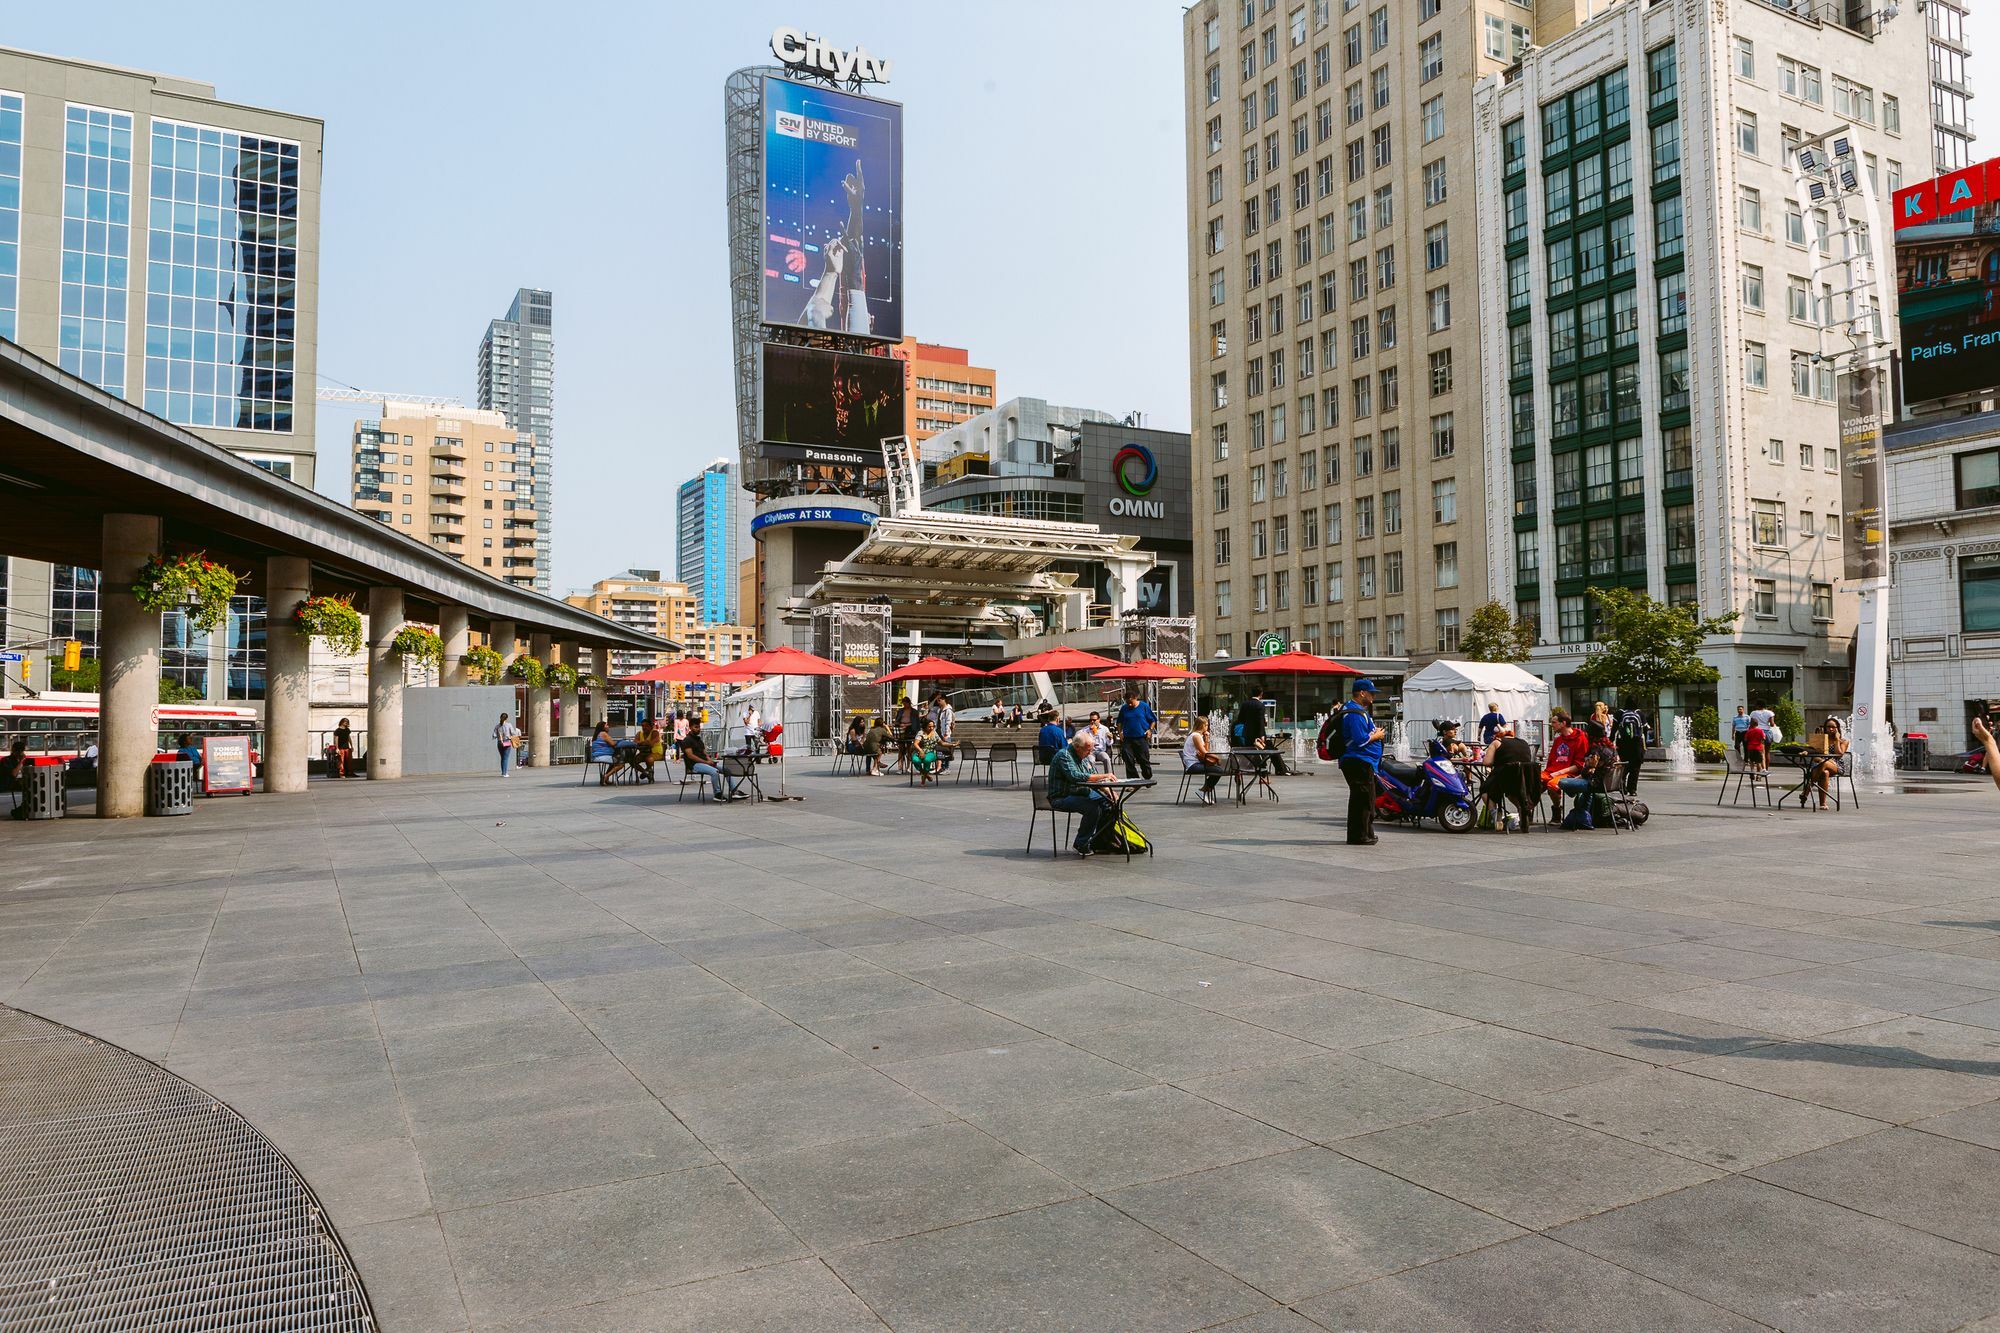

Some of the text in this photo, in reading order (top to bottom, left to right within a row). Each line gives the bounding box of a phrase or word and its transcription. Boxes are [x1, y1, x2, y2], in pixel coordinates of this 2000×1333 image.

[771, 26, 892, 84] Citytv
[779, 117, 801, 129] SN
[806, 119, 844, 135] UNITED
[806, 130, 857, 147] BY SPORT
[1904, 178, 1974, 218] KA
[1911, 341, 1957, 362] Paris,
[1843, 414, 1879, 428] YONGE-
[1843, 421, 1880, 436] DUNDAS
[1843, 430, 1880, 444] SQUARE
[805, 449, 863, 463] Panasonic
[1109, 498, 1164, 518] OMNI
[764, 510, 832, 524] CityNews AT SIX
[844, 643, 880, 651] YONGE-
[1560, 645, 1581, 654] HNR
[844, 656, 880, 664] SQUARE
[1754, 669, 1787, 679] INGLOT
